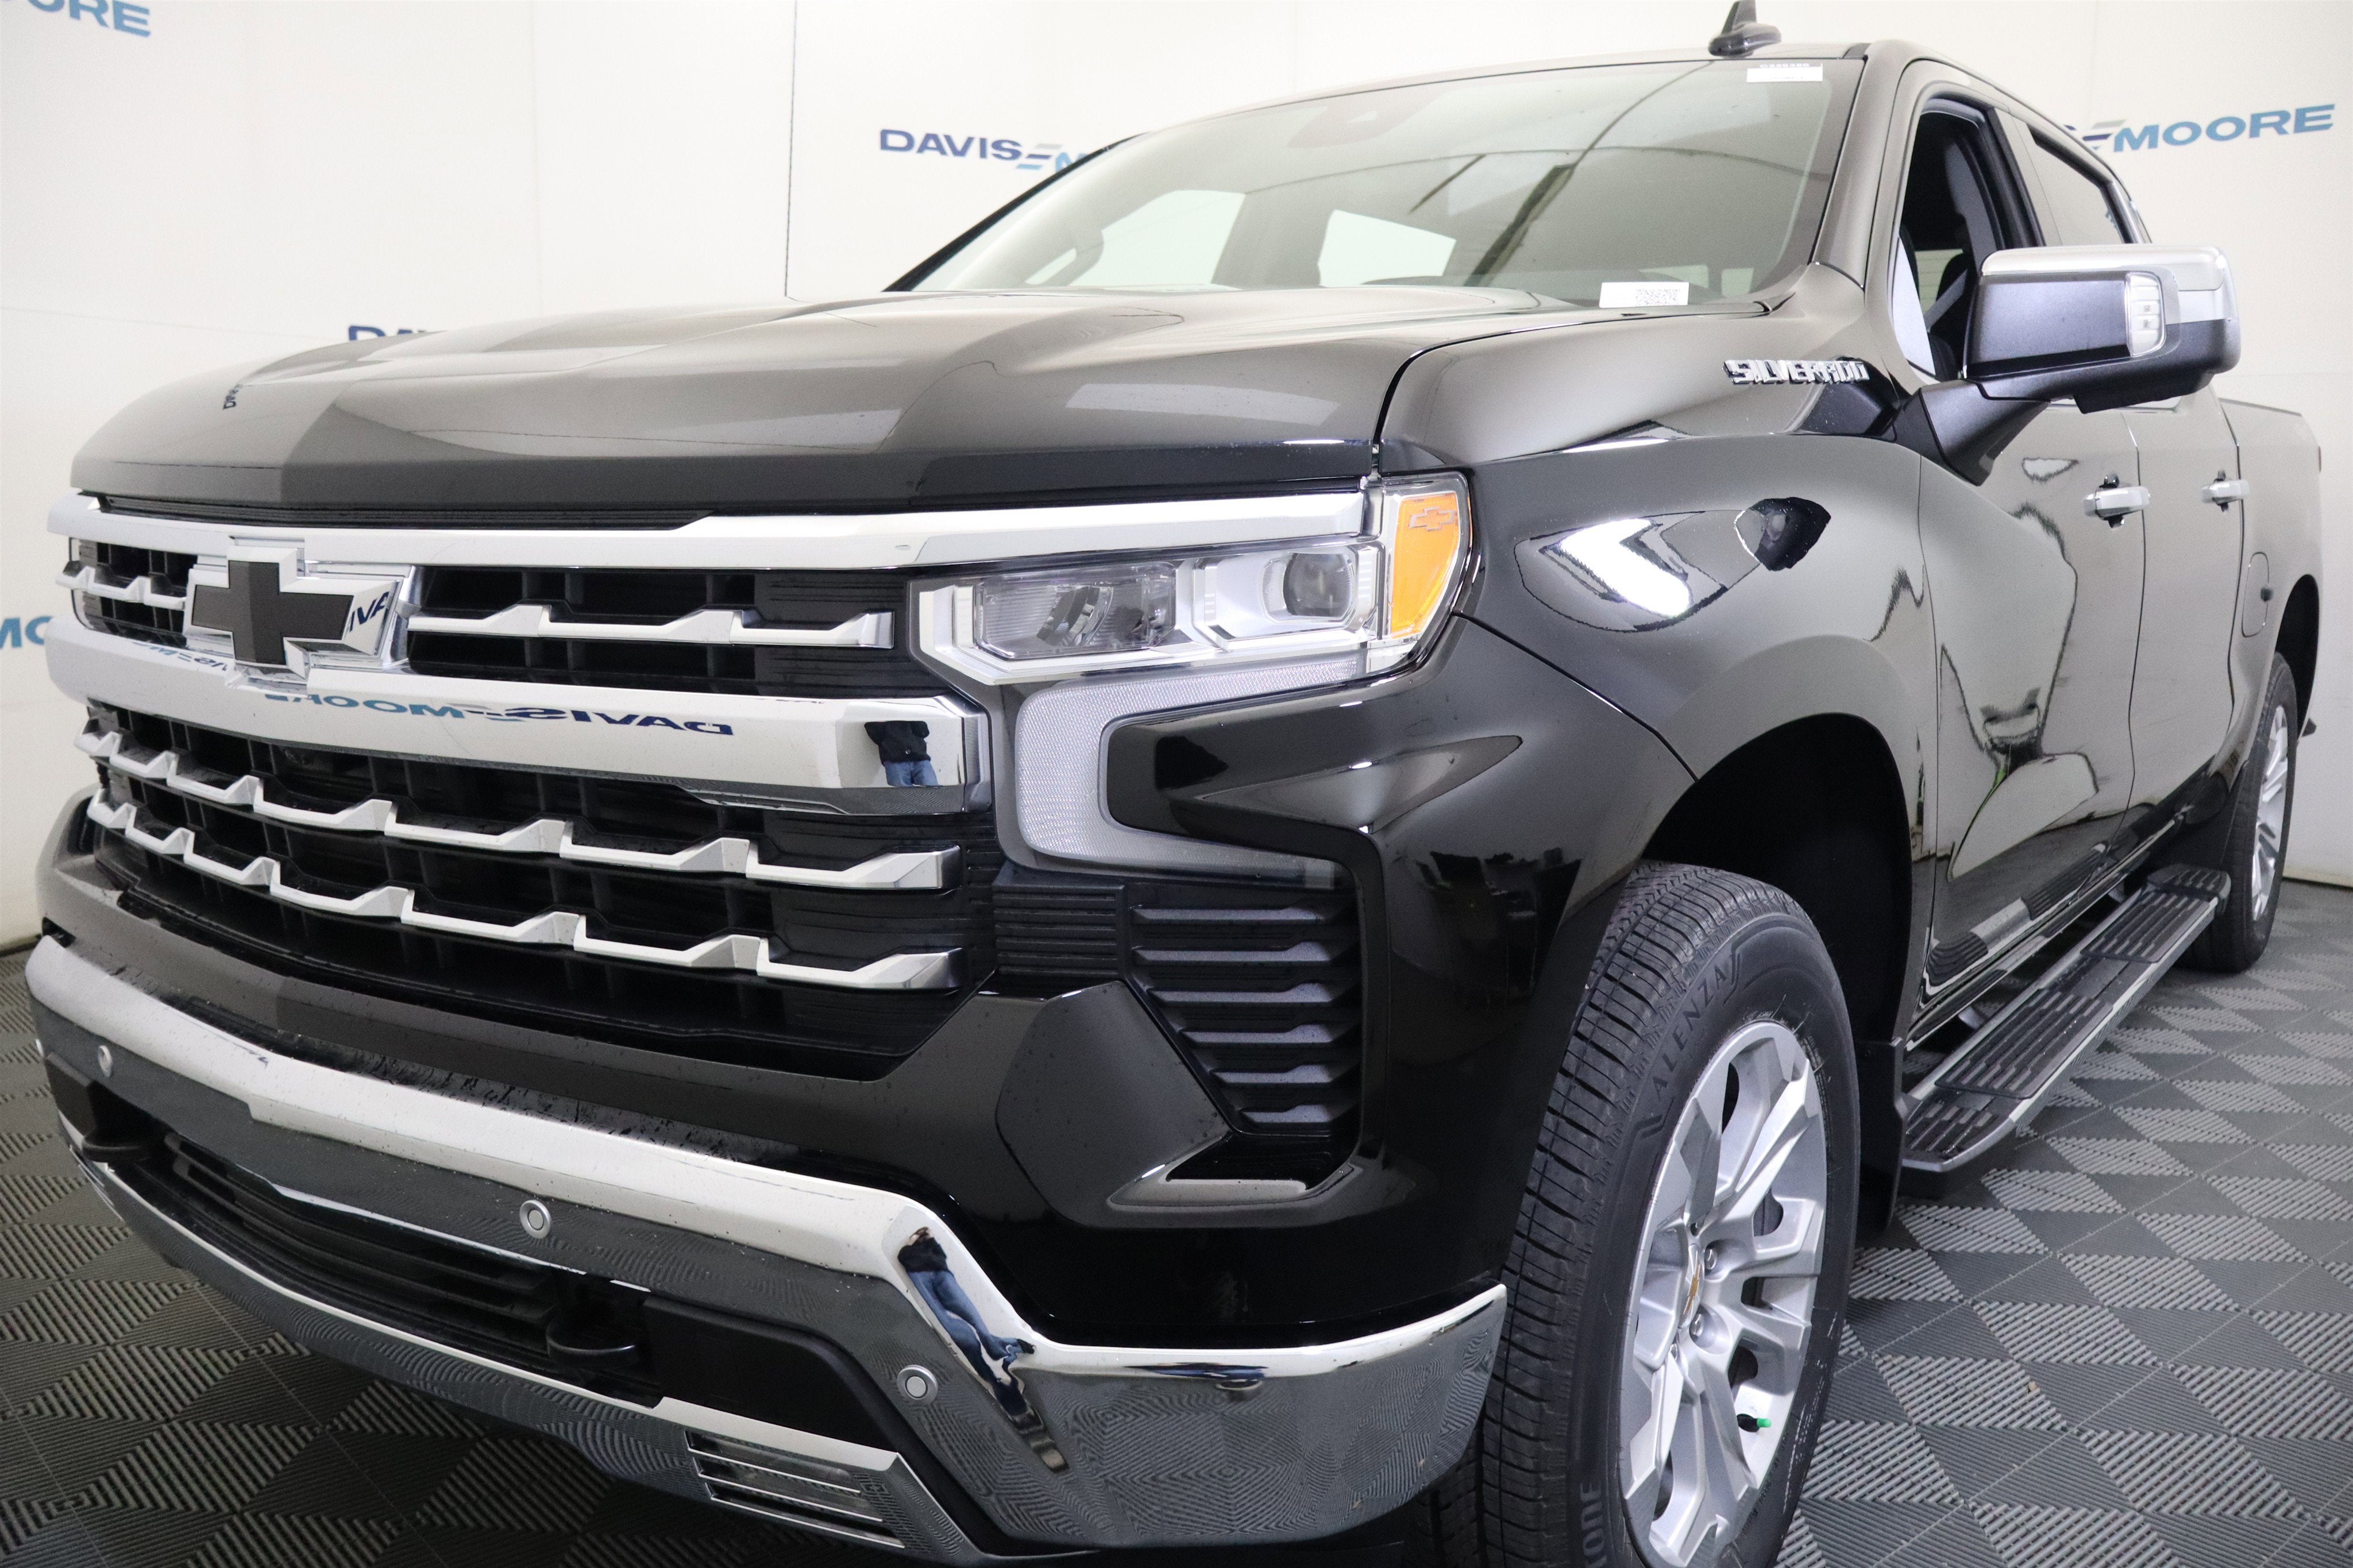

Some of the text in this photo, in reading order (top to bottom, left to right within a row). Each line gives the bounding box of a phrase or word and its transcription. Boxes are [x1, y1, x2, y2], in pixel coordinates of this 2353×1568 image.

[880, 129, 1023, 160] DAVIS
[2113, 103, 2336, 152] MOORE
[1722, 359, 1870, 384] SILVERADO
[1653, 964, 1728, 1098] ALENZA
